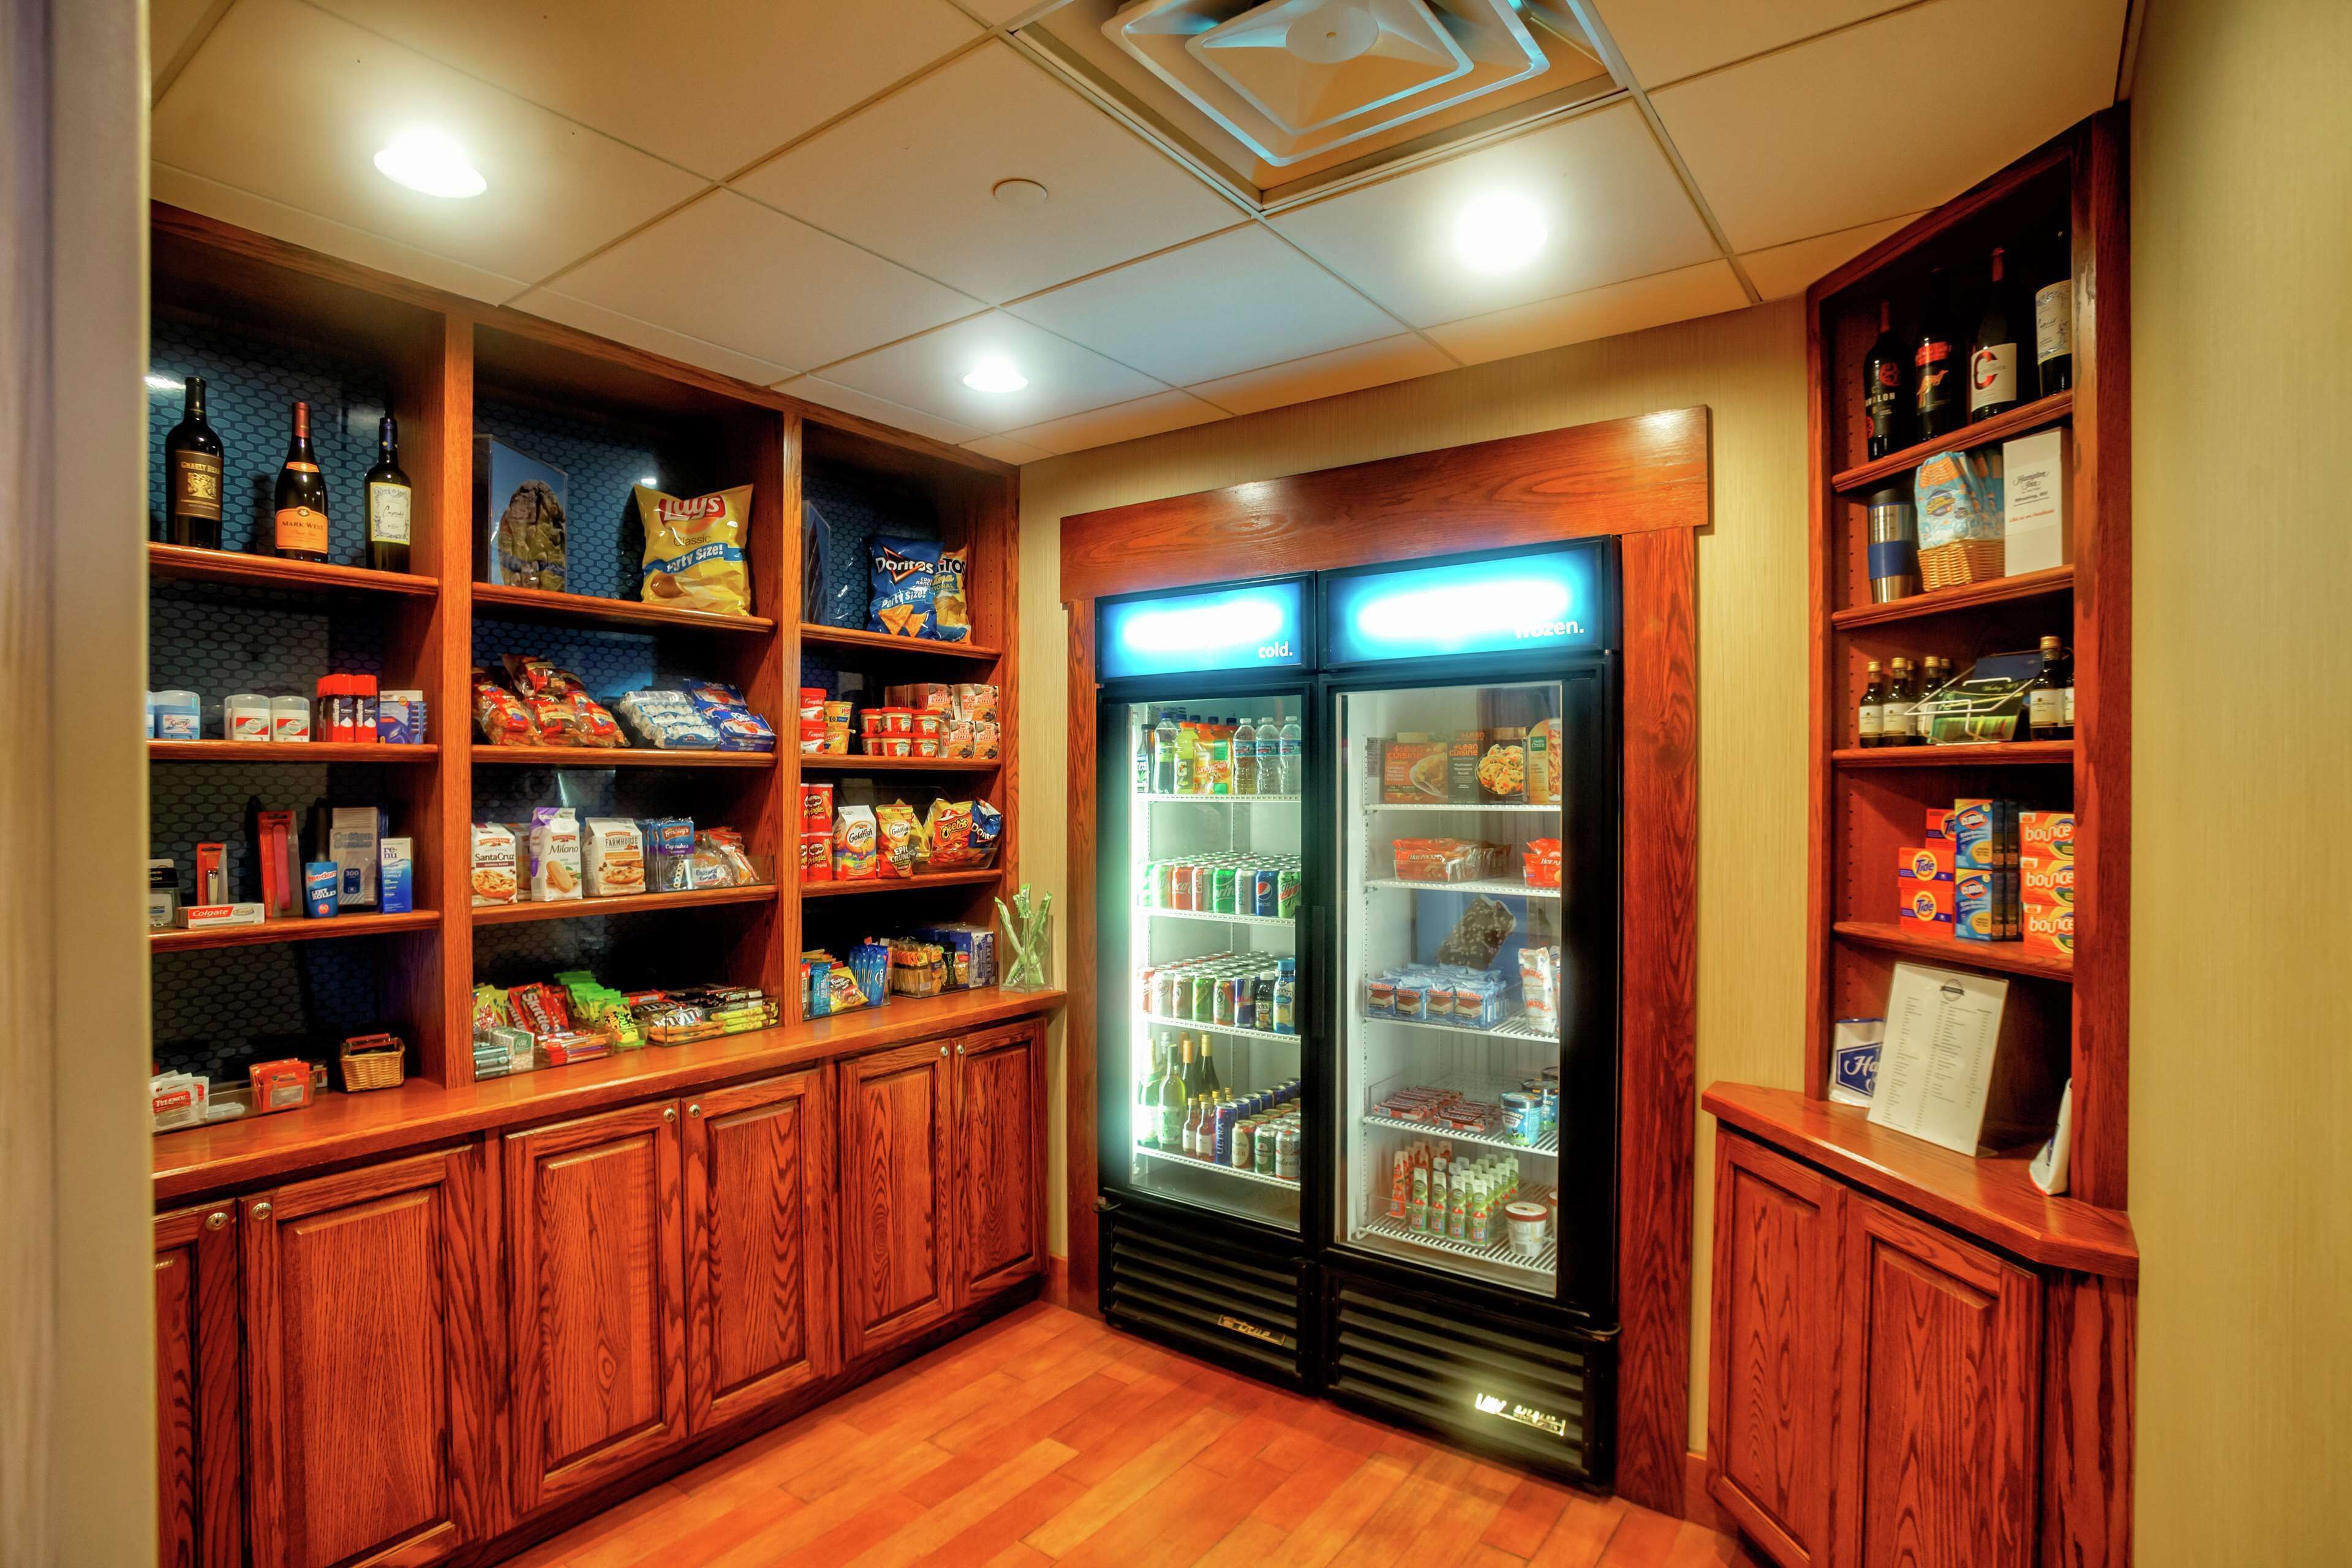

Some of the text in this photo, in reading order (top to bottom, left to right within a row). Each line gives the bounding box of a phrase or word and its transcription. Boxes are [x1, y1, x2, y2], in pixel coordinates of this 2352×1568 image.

[306, 522, 323, 531] WEST
[673, 535, 711, 546] Classic
[695, 545, 723, 560] Size!
[875, 557, 934, 574] Doritos
[881, 593, 903, 608] Party
[1258, 641, 1293, 658] cold.
[849, 828, 873, 843] Goldfish
[891, 827, 909, 835] Goldfish
[941, 818, 968, 841] Cheetos
[2024, 825, 2072, 842] bounce
[548, 843, 579, 855] Milano
[605, 836, 638, 848] FARMHOUSE
[807, 854, 826, 867] Pringles
[1915, 859, 1935, 873] Tide
[2026, 872, 2074, 887] bounce
[1915, 899, 1934, 913] Tide
[154, 1095, 186, 1107] TYLENOL
